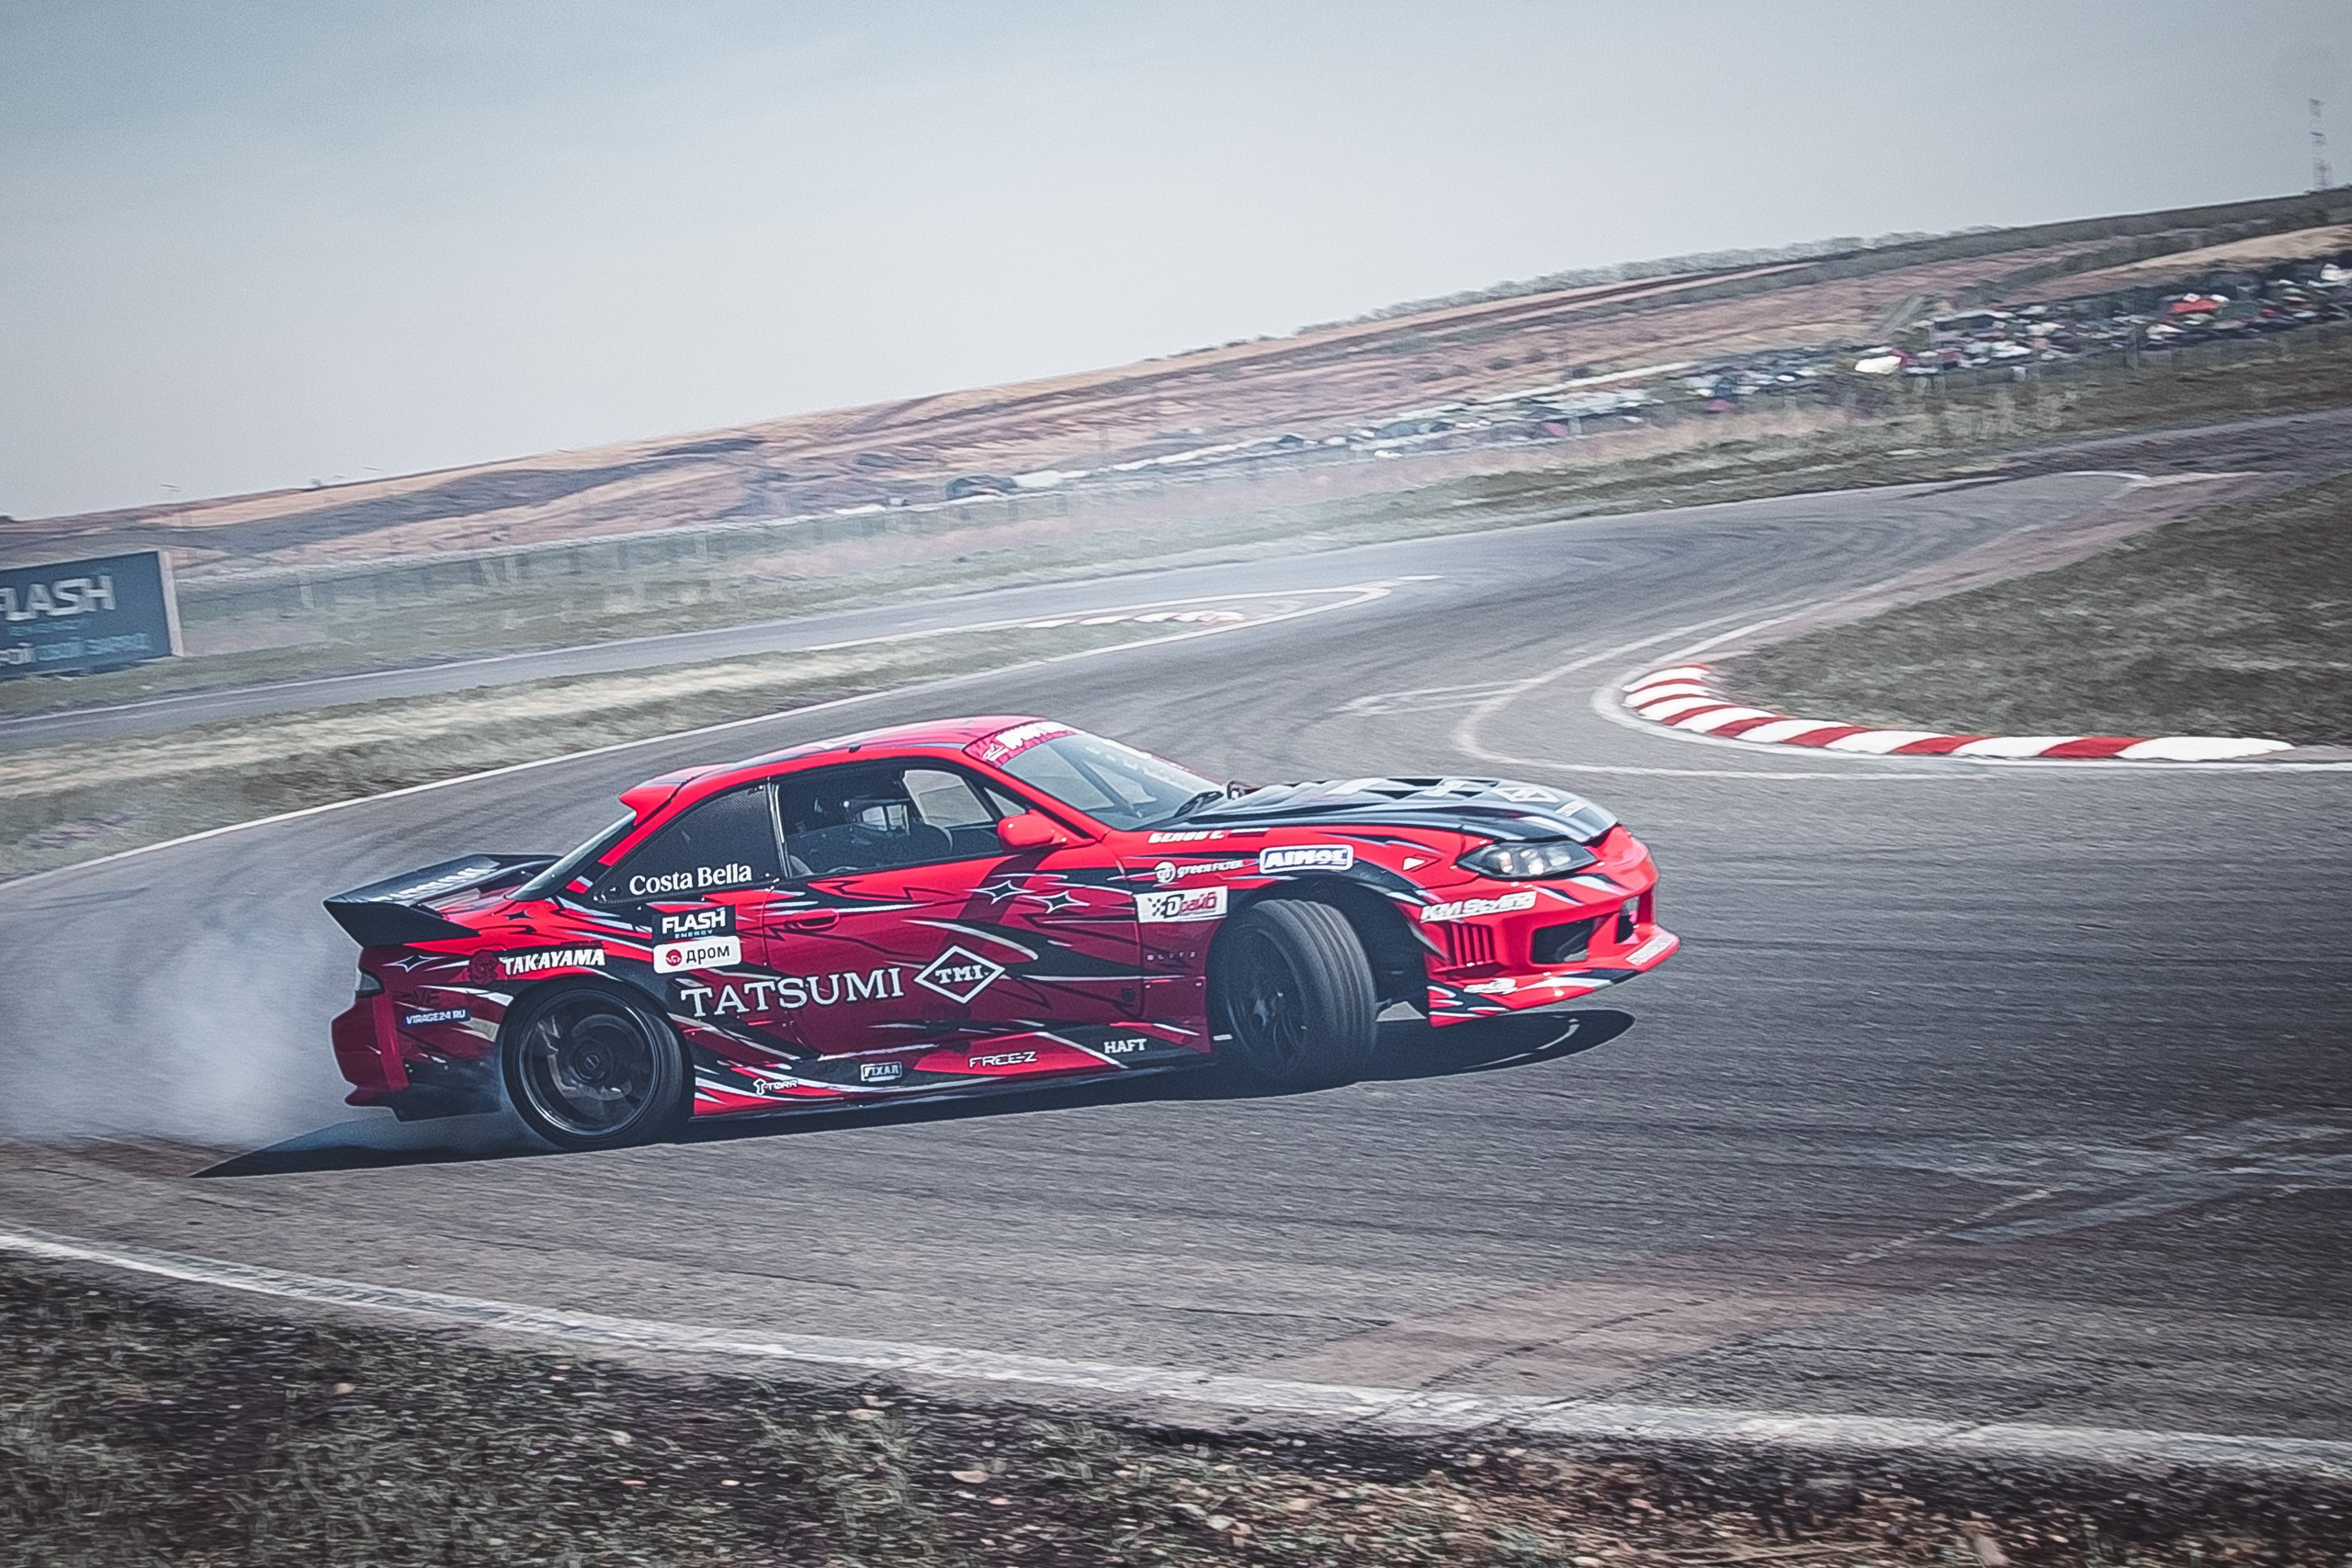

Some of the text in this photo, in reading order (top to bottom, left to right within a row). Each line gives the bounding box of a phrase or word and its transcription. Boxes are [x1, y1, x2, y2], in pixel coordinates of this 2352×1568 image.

[0, 575, 117, 621] LASH
[628, 863, 752, 896] Costa Bella
[662, 909, 726, 934] FLASH
[674, 930, 714, 940] ENERGY
[501, 948, 605, 976] TAKAYAMA
[685, 945, 730, 964] дром
[934, 964, 984, 984] TMI
[680, 967, 905, 1018] TATSUMI
[1103, 1038, 1148, 1054] HAFT
